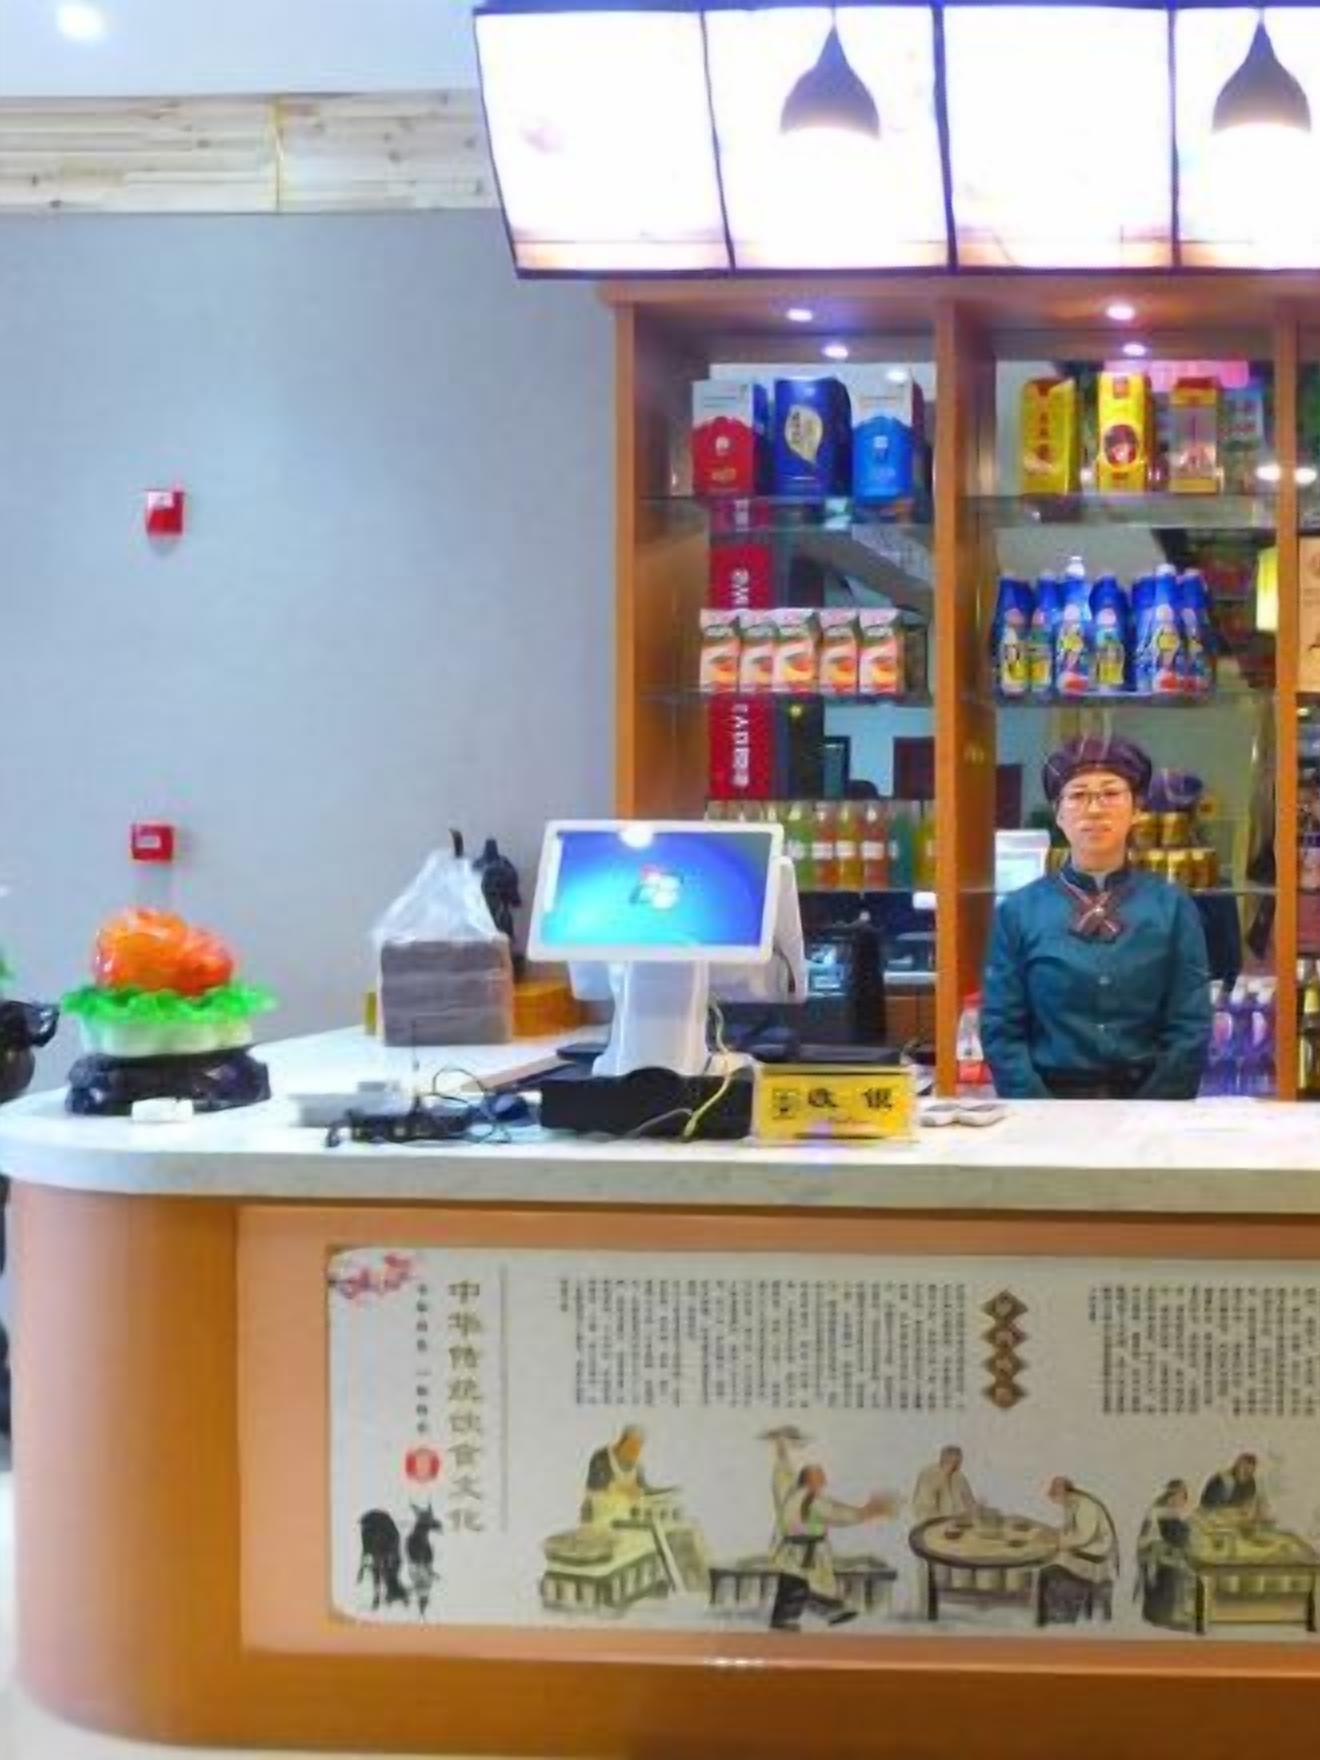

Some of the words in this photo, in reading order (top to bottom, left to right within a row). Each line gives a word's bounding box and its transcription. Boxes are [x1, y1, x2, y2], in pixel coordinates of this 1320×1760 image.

[447, 1279, 485, 1533] 中华传统饮食文化
